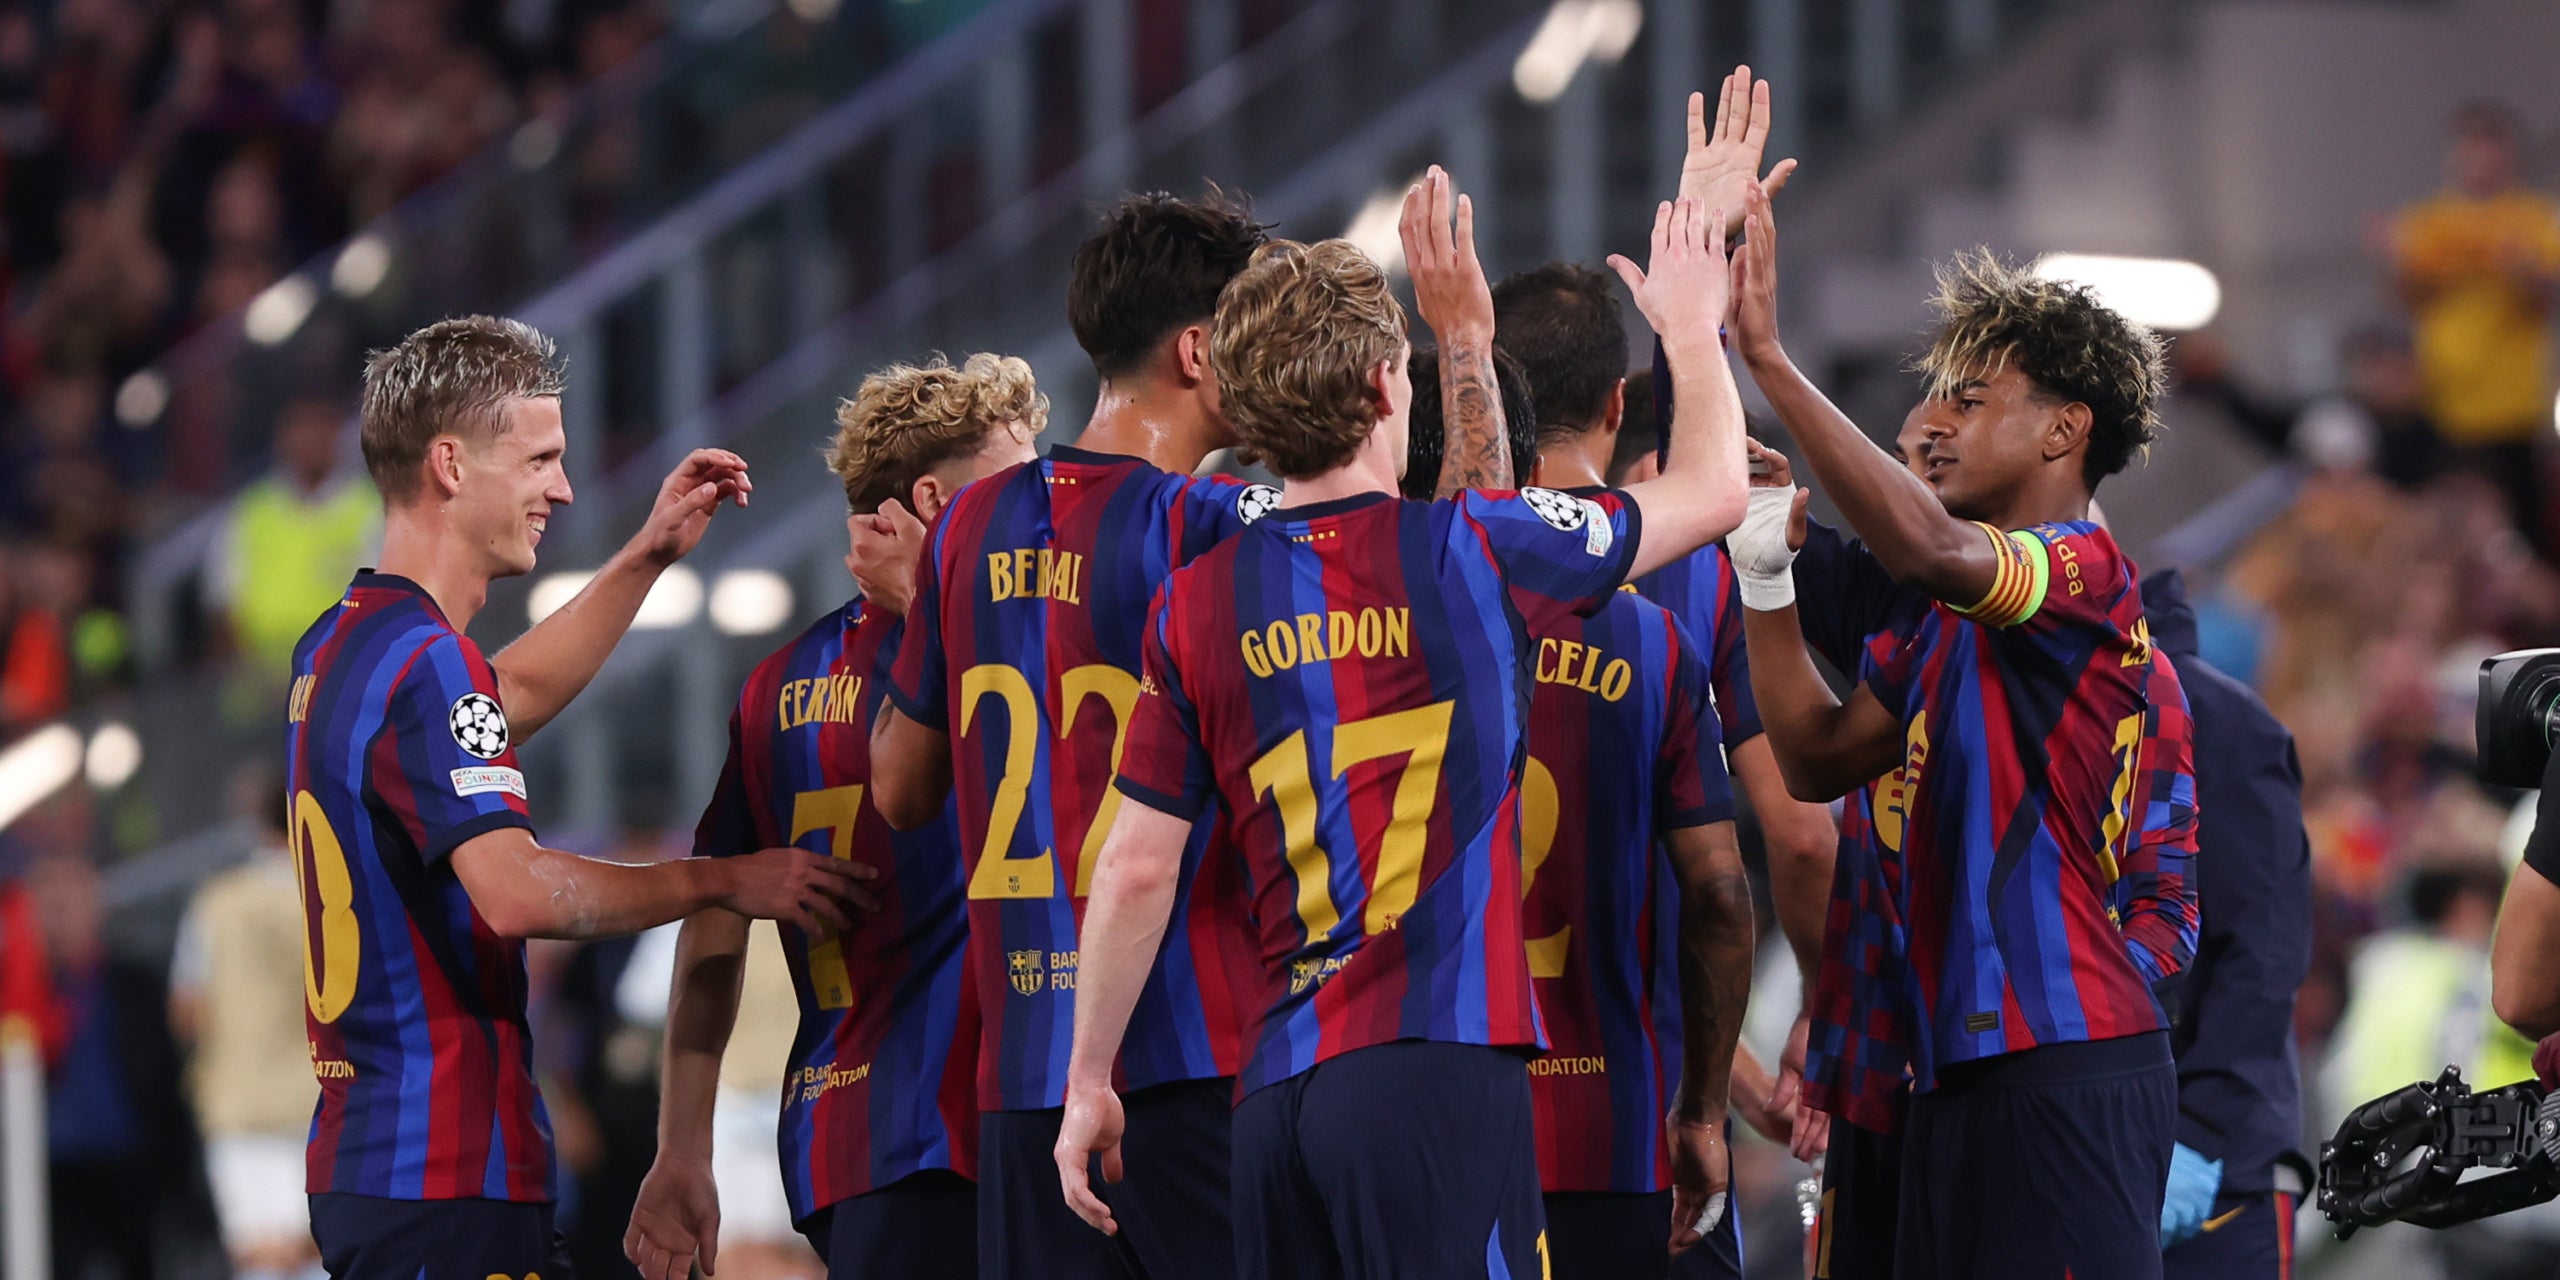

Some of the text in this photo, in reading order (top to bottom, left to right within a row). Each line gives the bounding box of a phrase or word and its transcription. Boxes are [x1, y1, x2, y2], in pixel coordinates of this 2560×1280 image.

[1241, 607, 1409, 678] GORDON
[790, 783, 864, 1010] 7
[960, 663, 1140, 900] 22
[1249, 699, 1456, 946] 17
